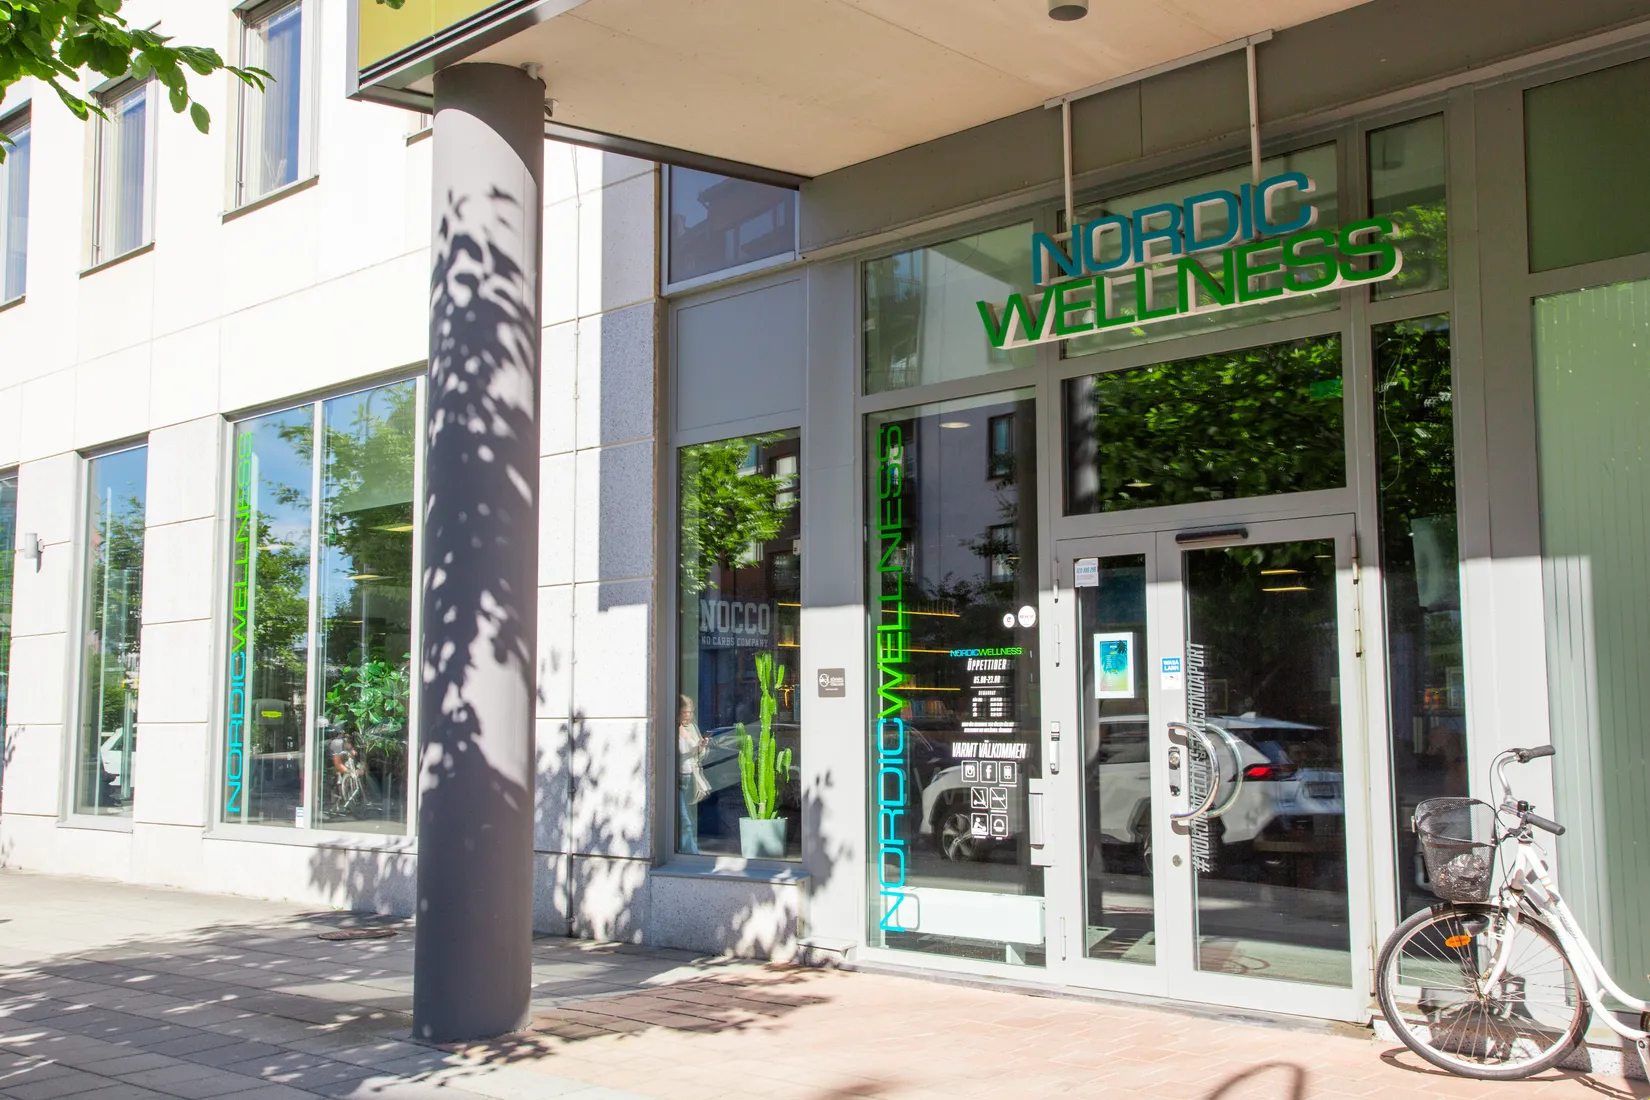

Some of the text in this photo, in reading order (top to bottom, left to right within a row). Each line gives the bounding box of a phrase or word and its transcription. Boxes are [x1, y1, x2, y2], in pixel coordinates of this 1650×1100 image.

[1032, 171, 1314, 286] NORDIC
[976, 217, 1399, 349] WELLNESS
[226, 431, 253, 813] NORDICWELLNESS
[700, 599, 771, 635] NOCCO
[702, 636, 769, 648] NO CARBS COMPANY
[949, 647, 1023, 657] NORDICWELLNESS
[876, 425, 905, 933] NORDICWELLNESS
[967, 658, 1007, 671] ÖPPETTIDER
[952, 740, 1027, 759] VARMT VÄLKOMMEN
